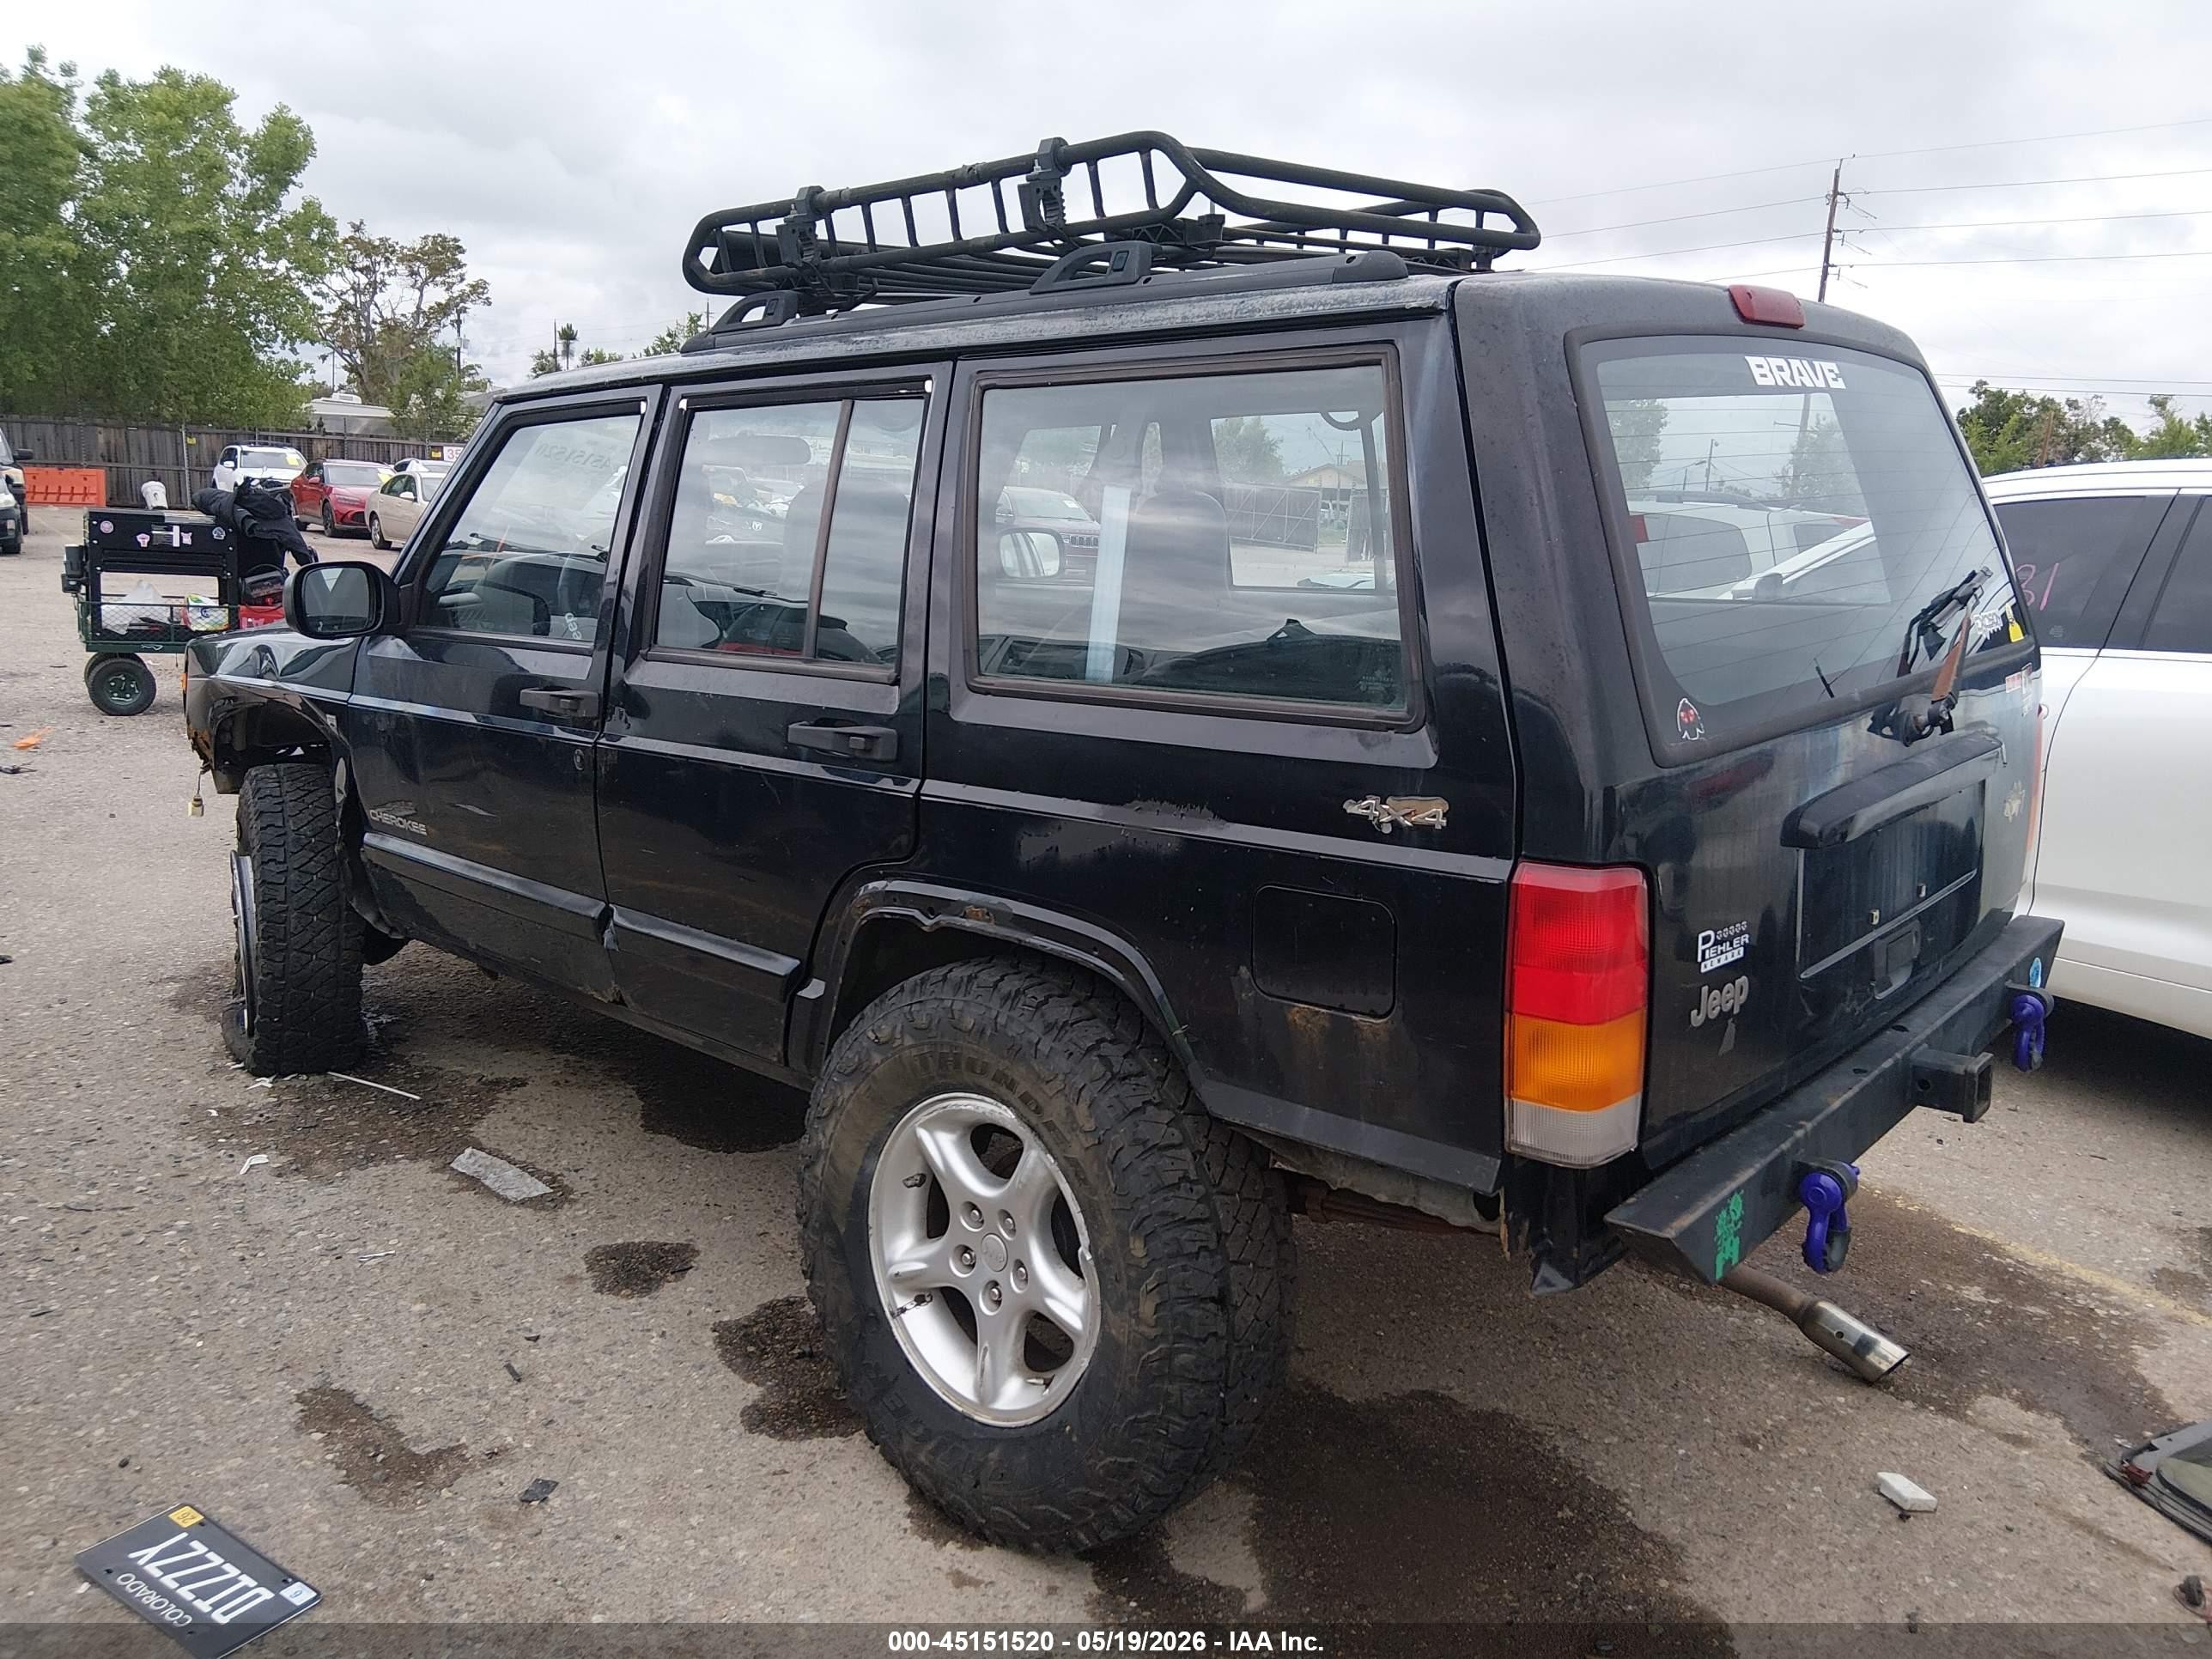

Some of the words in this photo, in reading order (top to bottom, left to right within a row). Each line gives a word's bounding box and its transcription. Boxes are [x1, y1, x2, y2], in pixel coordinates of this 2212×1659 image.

[1744, 356, 1846, 389] BRAVE
[564, 612, 582, 641] eep
[369, 809, 428, 836] CHEROKEE
[1697, 929, 1750, 963] PIEHLER
[1702, 947, 1743, 971] NEWARK
[1690, 975, 1749, 1027] Jeep
[127, 1532, 276, 1625] DIZZZY
[116, 1572, 193, 1627] COLORADO
